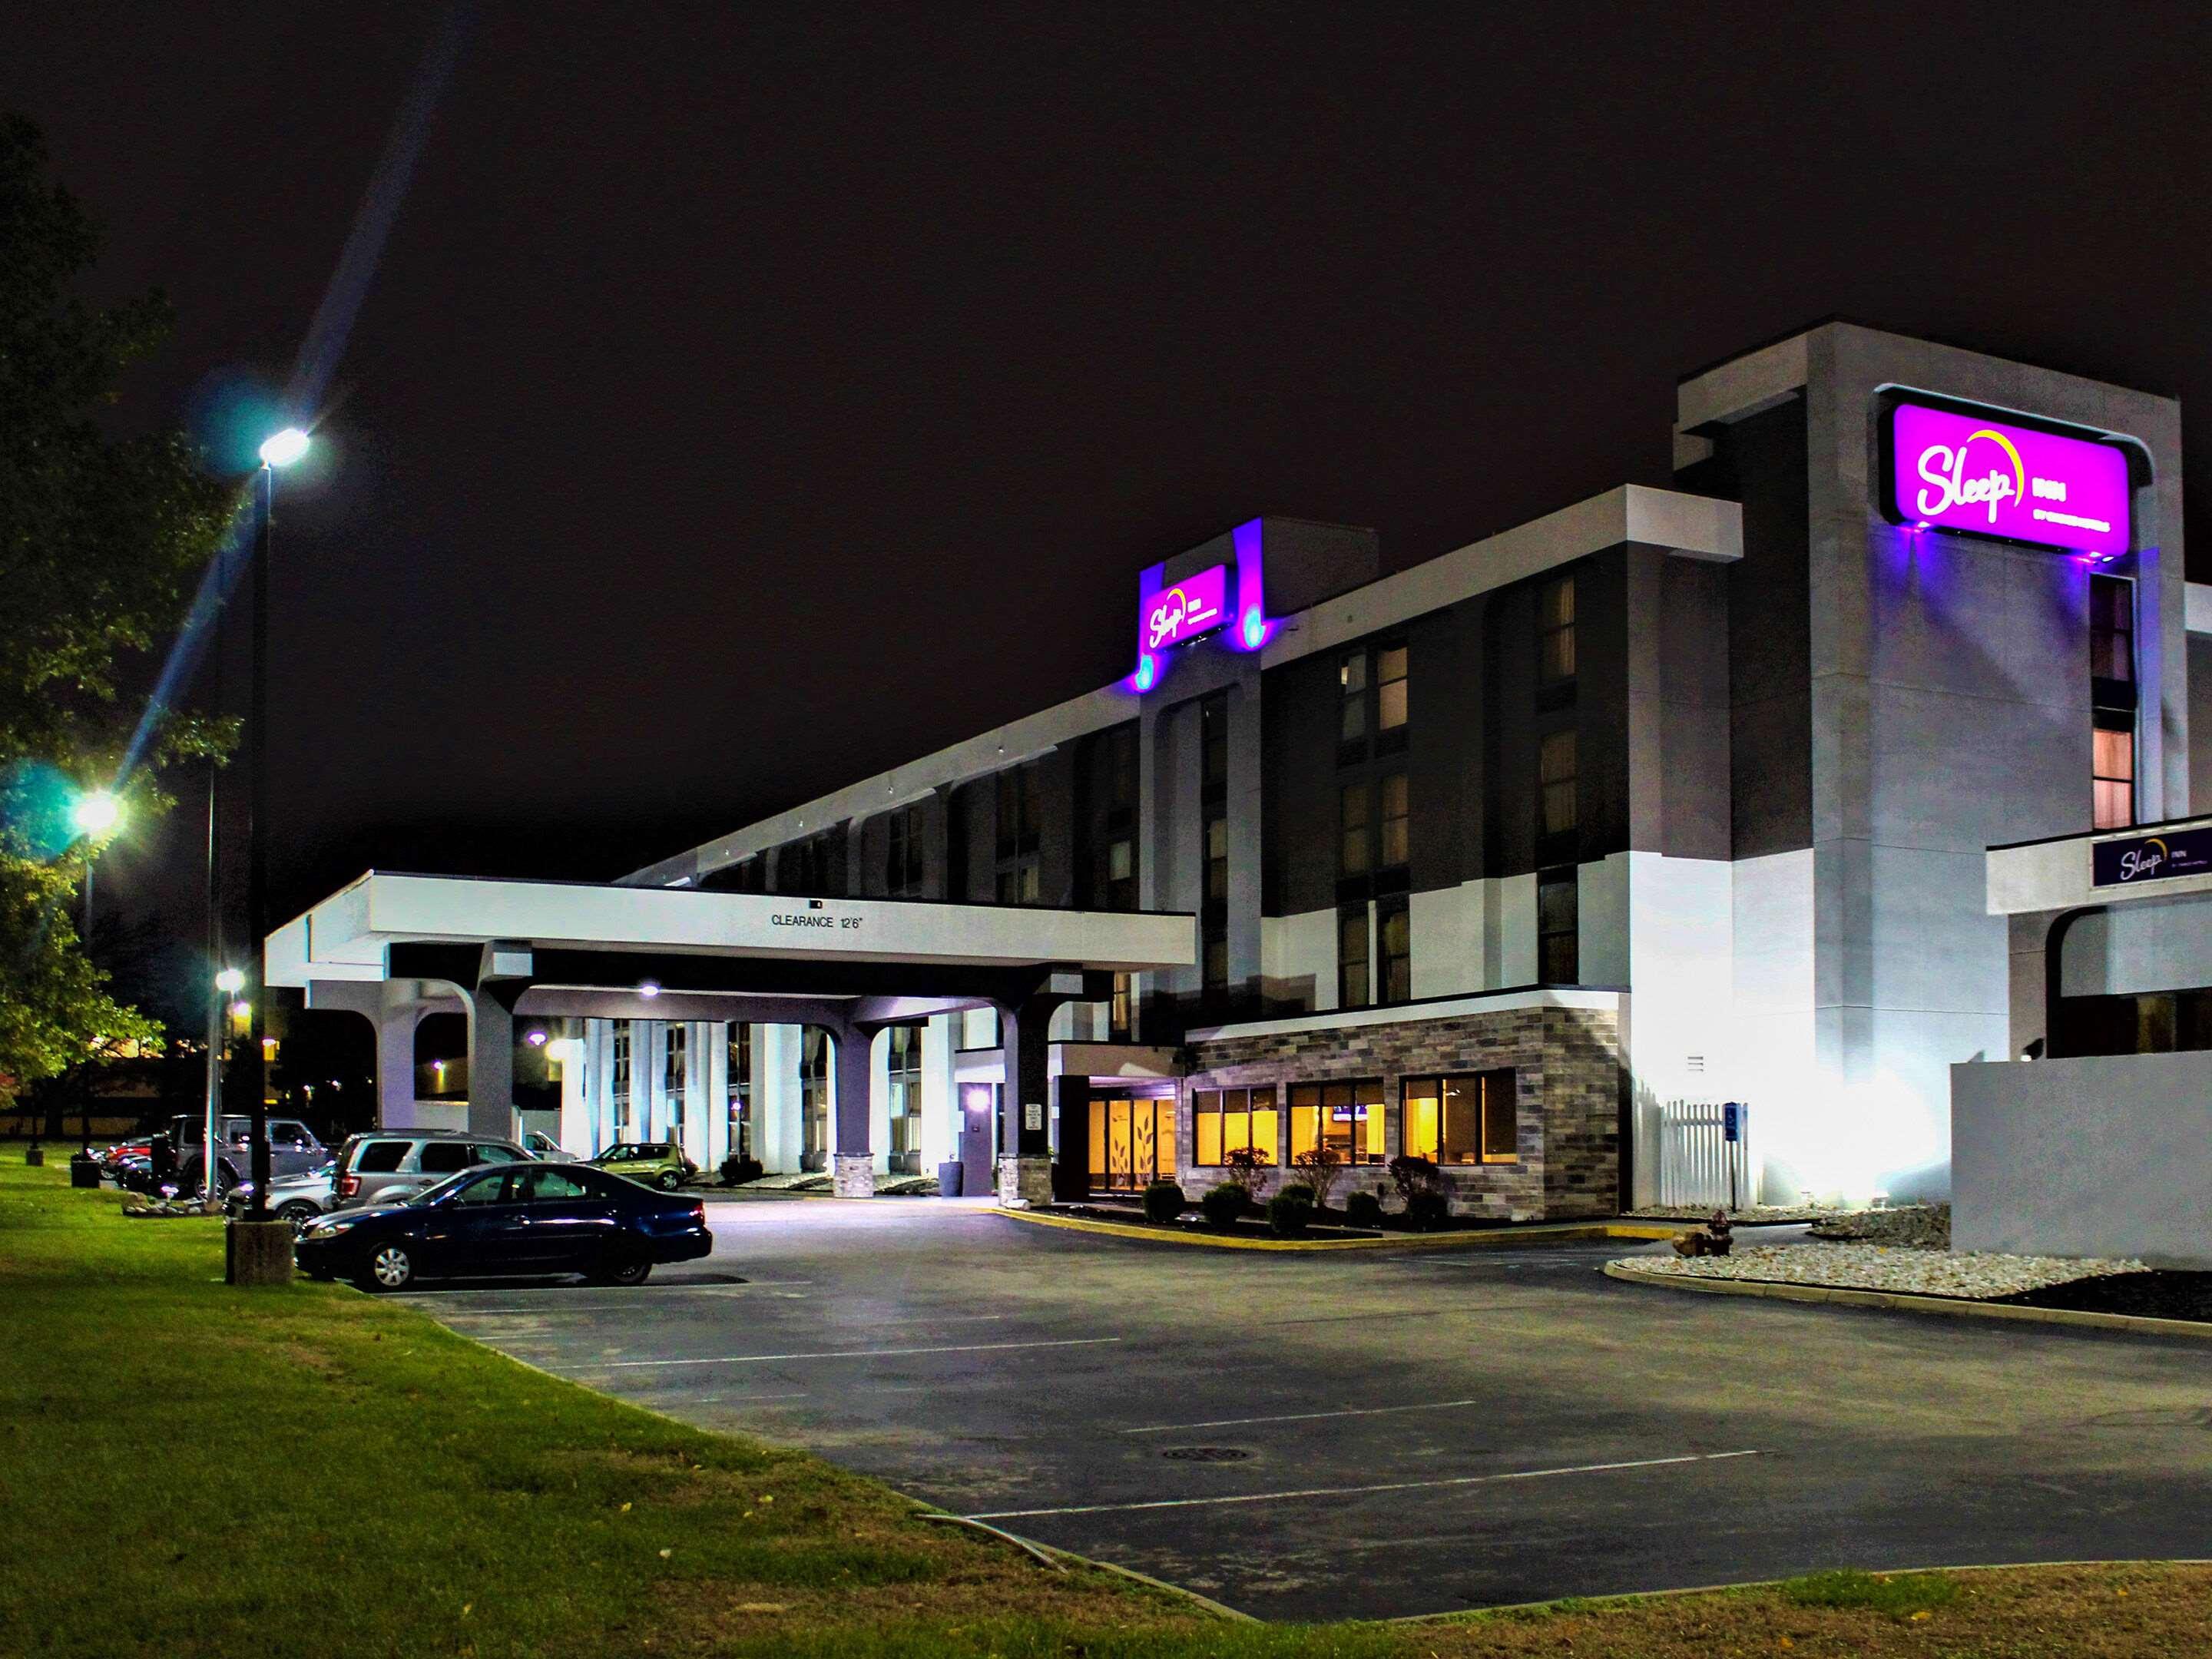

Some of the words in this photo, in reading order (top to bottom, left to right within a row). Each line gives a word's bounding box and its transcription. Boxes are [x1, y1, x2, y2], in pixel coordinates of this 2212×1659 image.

[1917, 445, 2015, 524] Sleep
[1149, 604, 1184, 649] Slp
[2120, 849, 2163, 880] Sleep
[771, 914, 834, 928] CLEARANCE
